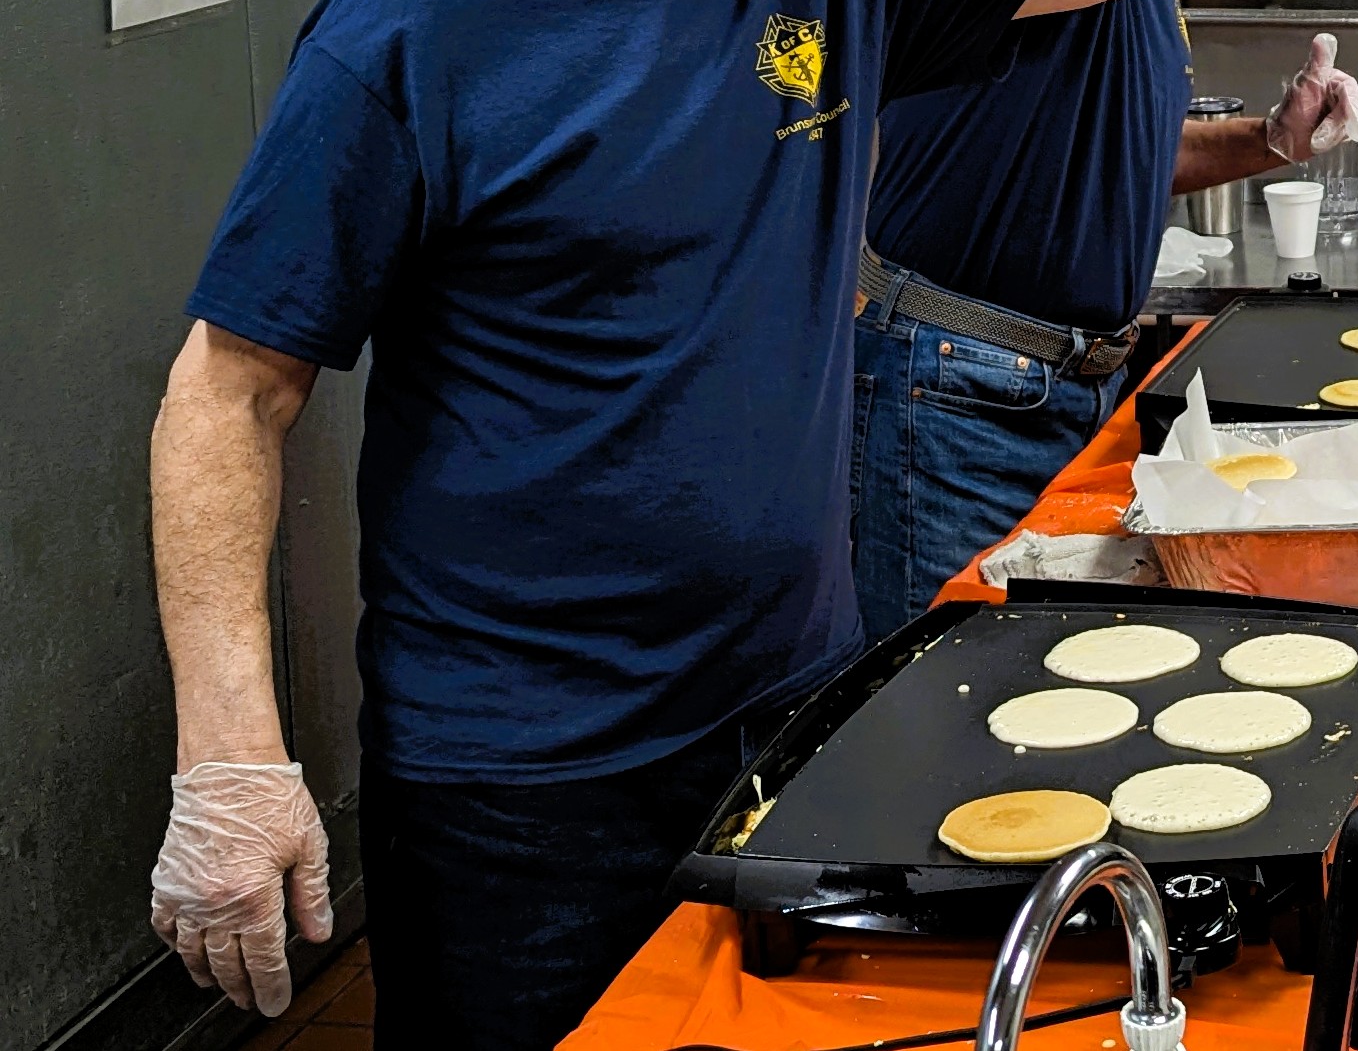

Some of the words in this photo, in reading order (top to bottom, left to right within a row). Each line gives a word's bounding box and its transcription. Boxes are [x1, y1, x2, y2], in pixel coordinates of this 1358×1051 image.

[768, 42, 782, 58] K
[781, 35, 797, 50] OF
[797, 28, 813, 42] C
[815, 98, 851, 124] Council
